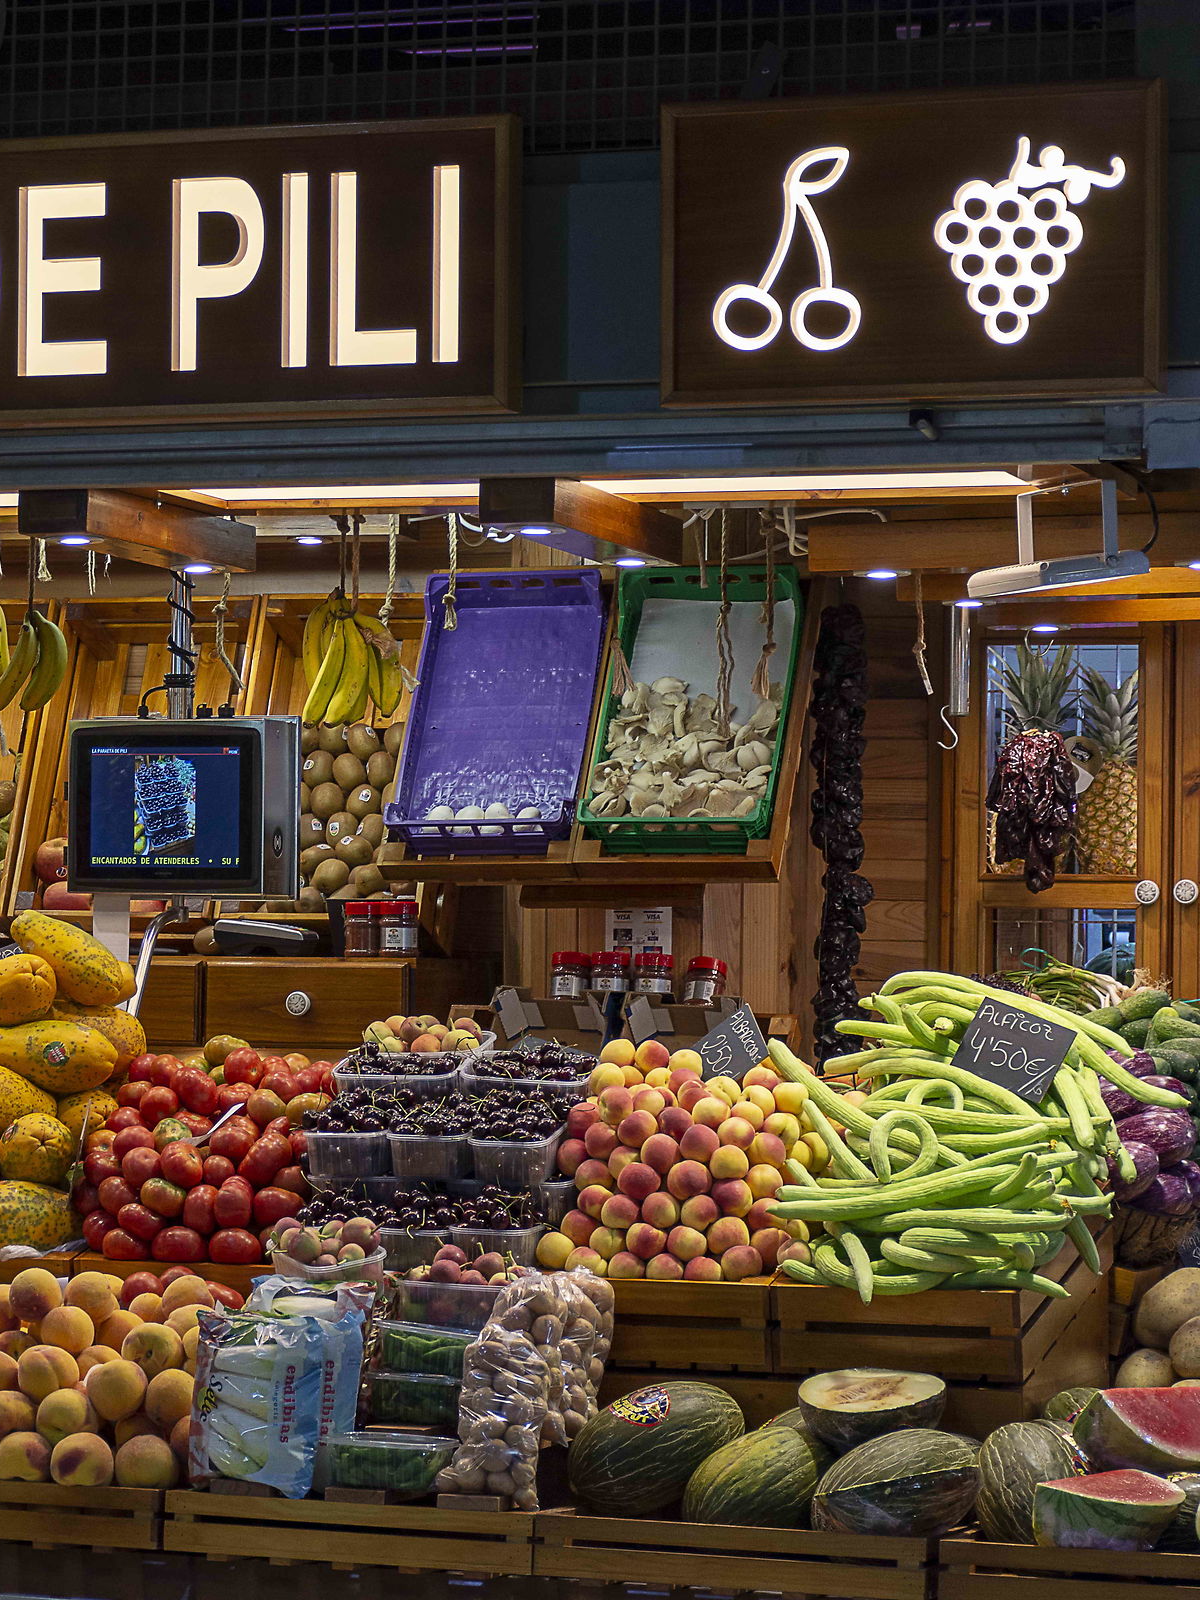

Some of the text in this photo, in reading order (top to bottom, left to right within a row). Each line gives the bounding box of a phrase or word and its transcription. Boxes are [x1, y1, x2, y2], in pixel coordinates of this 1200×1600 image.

[170, 164, 461, 372] PILI
[91, 857, 137, 865] ENCANTADOS
[140, 857, 150, 865] DE
[154, 857, 200, 865] ATENDERLES
[221, 857, 232, 865] SU
[279, 1364, 297, 1444] endibias
